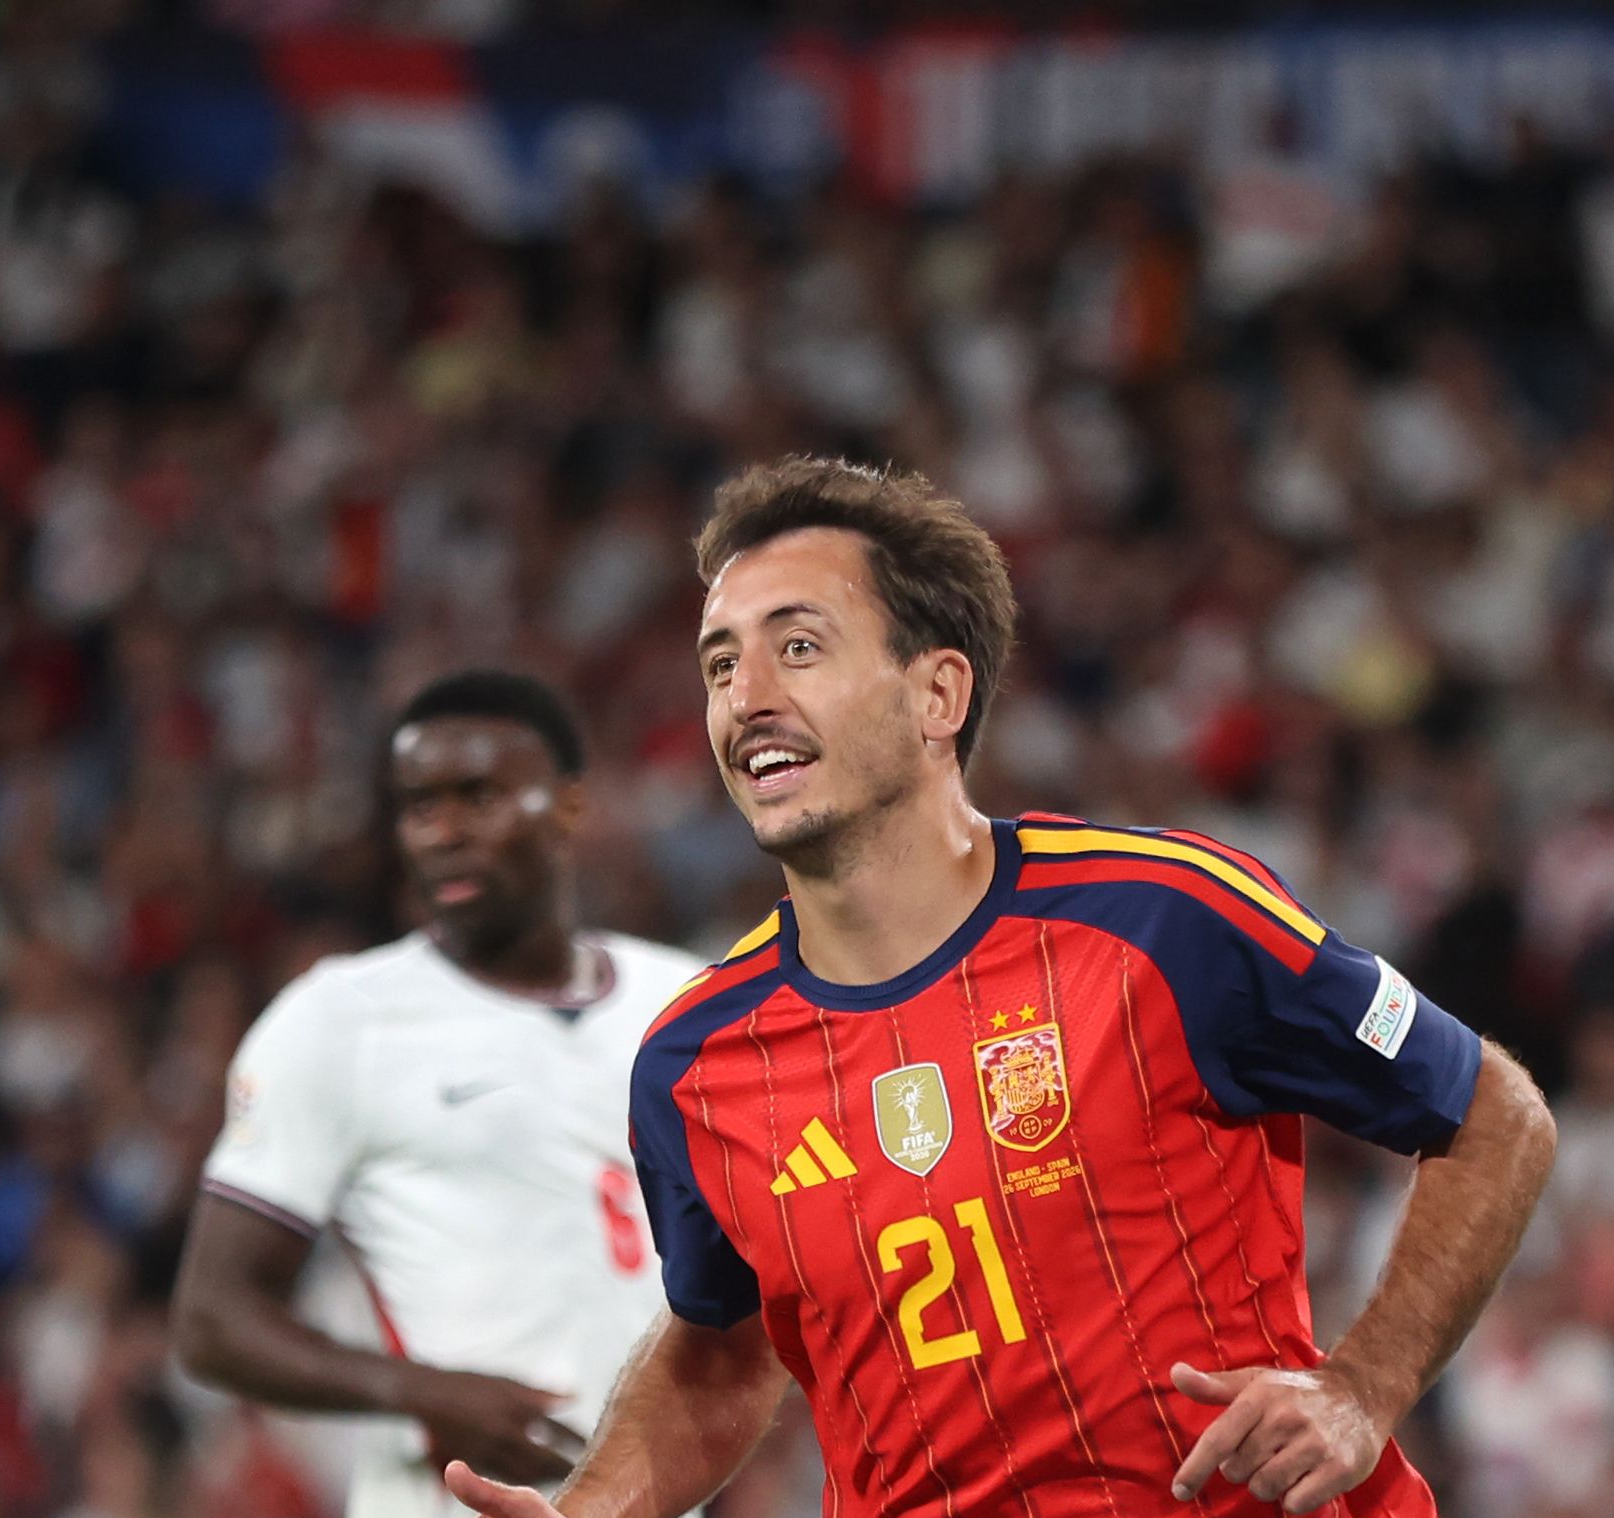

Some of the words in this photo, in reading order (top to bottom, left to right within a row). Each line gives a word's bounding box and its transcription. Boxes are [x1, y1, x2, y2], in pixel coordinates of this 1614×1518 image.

[1361, 1012, 1379, 1039] UEFA
[902, 1131, 935, 1151] FIFA
[1007, 1166, 1041, 1182] ENGLAND
[1047, 1157, 1070, 1172] SPAIN
[1015, 1171, 1060, 1192] SEPTEMBER
[1061, 1165, 1082, 1179] 2026
[1029, 1182, 1061, 1198] LONDON
[596, 1162, 646, 1279] 6
[877, 1197, 1027, 1370] 21
